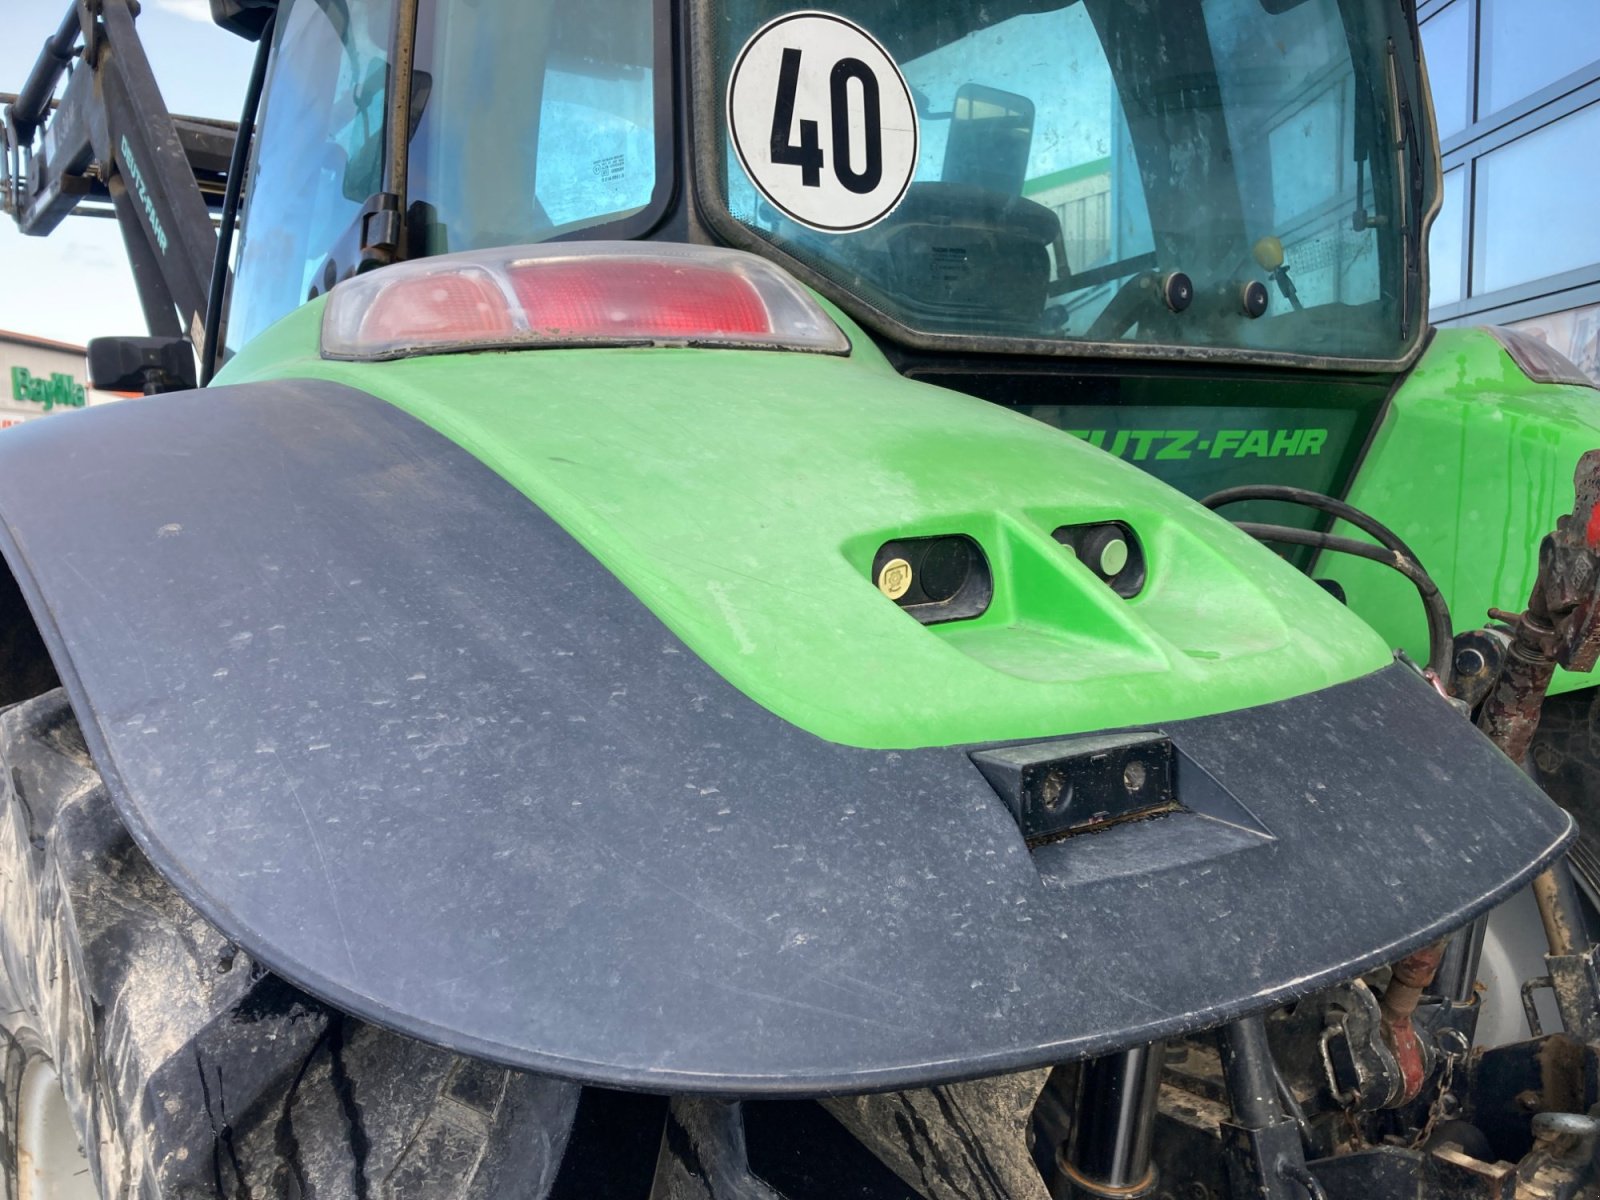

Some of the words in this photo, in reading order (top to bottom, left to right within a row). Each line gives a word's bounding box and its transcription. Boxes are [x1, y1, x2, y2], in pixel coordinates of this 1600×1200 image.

[770, 47, 882, 194] 40
[121, 134, 168, 256] DEUTZ-FAHR
[11, 366, 86, 412] BayWa
[1064, 428, 1328, 460] UTZ-FAHR
